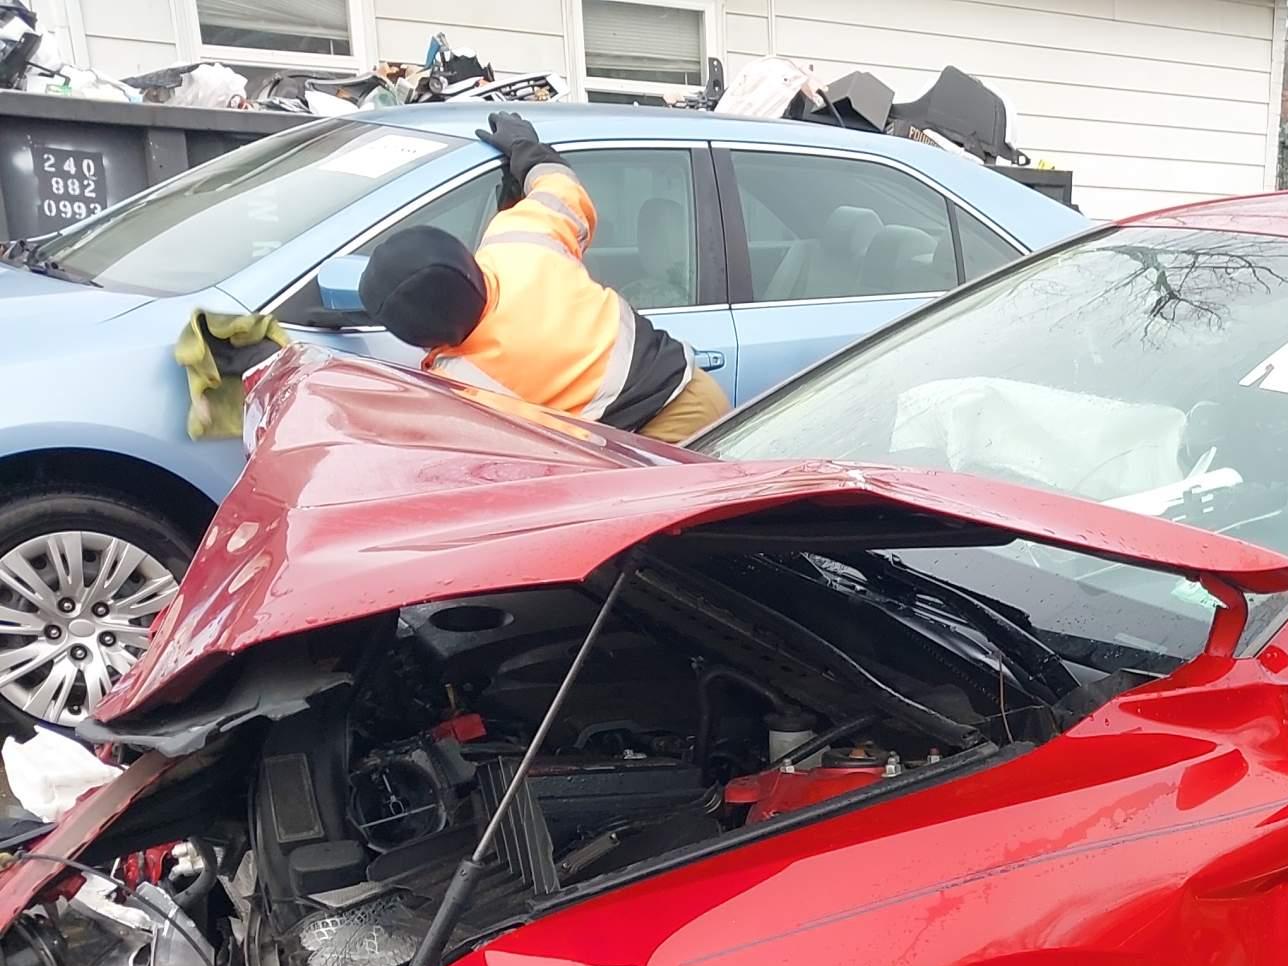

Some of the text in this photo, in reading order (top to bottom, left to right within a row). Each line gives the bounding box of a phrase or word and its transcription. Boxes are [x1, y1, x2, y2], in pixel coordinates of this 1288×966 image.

[43, 153, 96, 179] 240
[51, 177, 97, 198] 882
[43, 199, 102, 219] 0993
